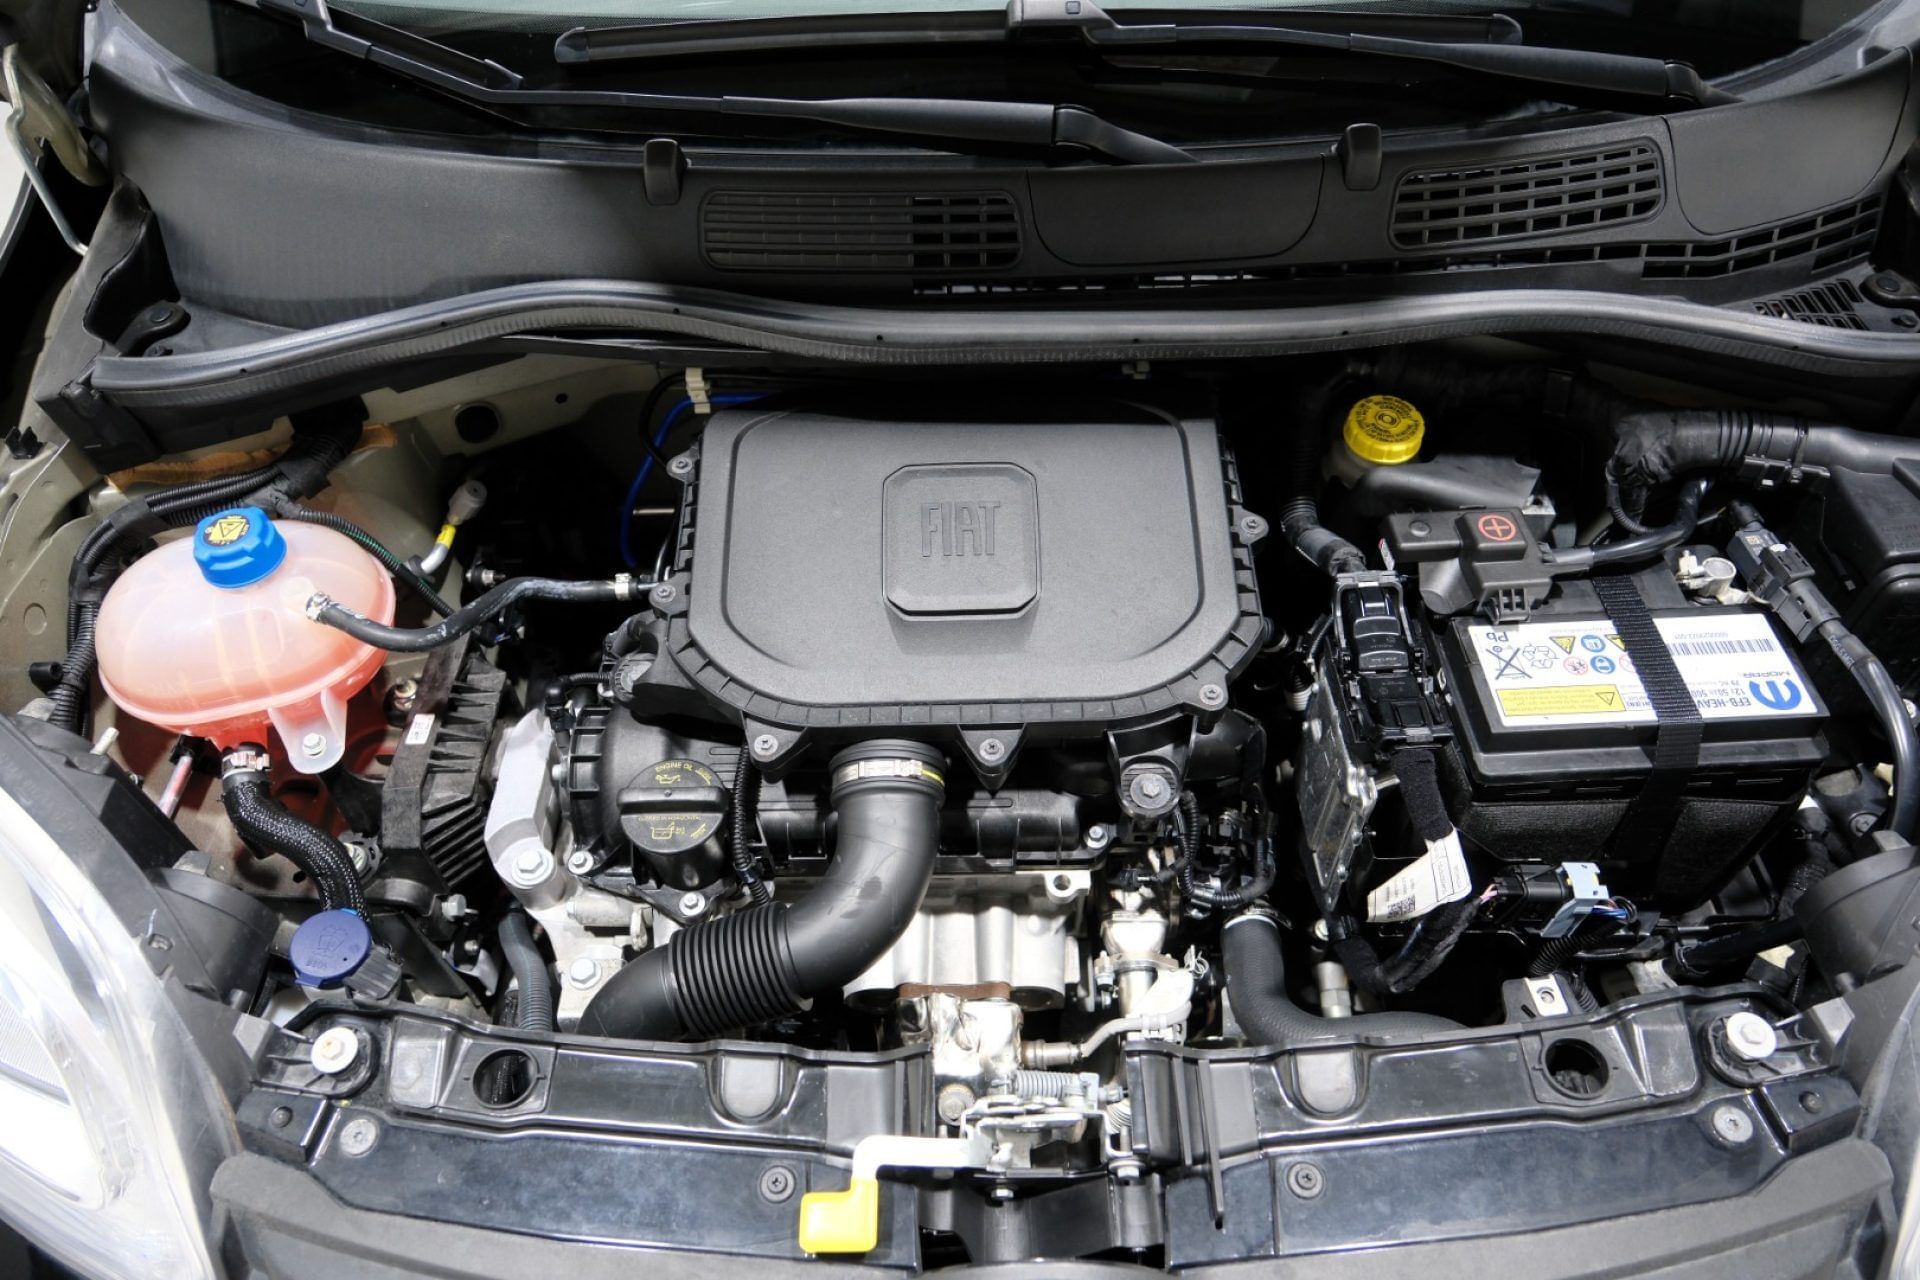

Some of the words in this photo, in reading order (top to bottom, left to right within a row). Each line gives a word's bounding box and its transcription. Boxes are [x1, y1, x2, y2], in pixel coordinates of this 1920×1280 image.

[920, 500, 1001, 557] FIAT
[1486, 632, 1509, 642] Pb
[655, 762, 682, 772] ENGINE
